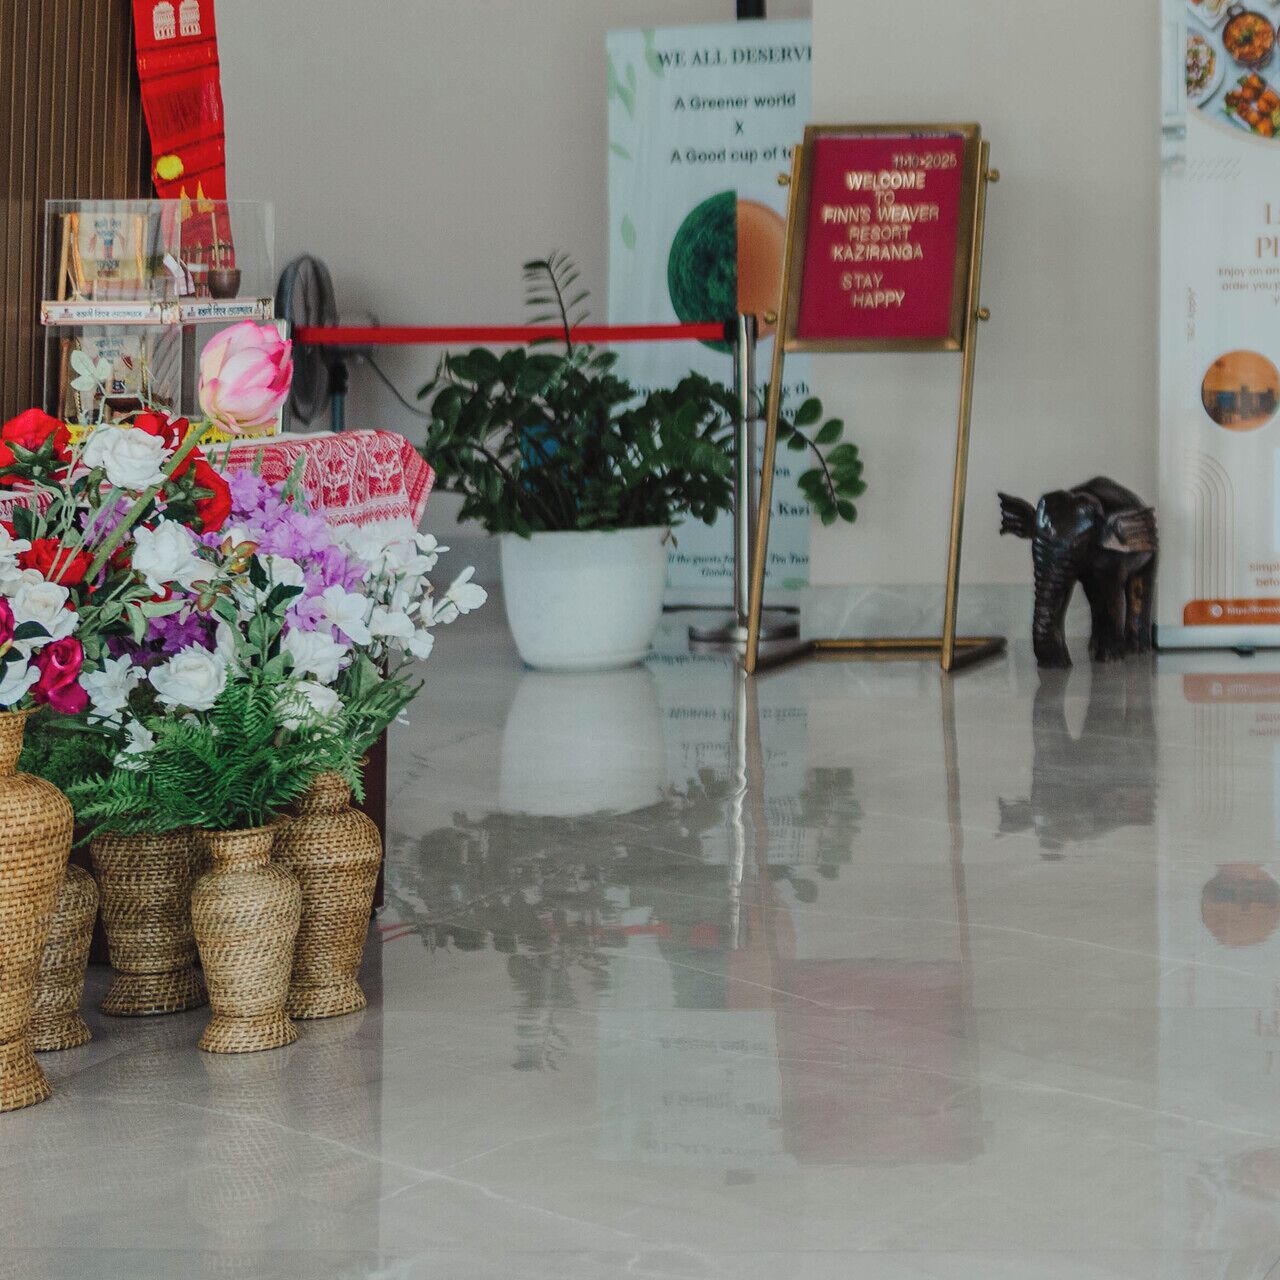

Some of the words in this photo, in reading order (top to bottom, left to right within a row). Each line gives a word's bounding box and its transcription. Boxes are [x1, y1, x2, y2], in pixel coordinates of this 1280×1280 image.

[657, 51, 687, 67] WE
[692, 49, 728, 66] ALL
[674, 98, 686, 110] A
[690, 96, 749, 110] Greener
[754, 93, 796, 107] world
[670, 150, 682, 164] A
[686, 149, 726, 163] Good
[731, 151, 758, 164] cup
[763, 147, 778, 160] of
[847, 171, 926, 191] WELCOME
[874, 190, 895, 206] TO
[823, 204, 871, 223] FINN'S
[877, 204, 939, 223] WEAVER
[849, 224, 912, 242] RESORT
[831, 243, 924, 262] KAZIRANGA
[842, 271, 883, 290] STAY
[853, 290, 905, 308] HAPPY
